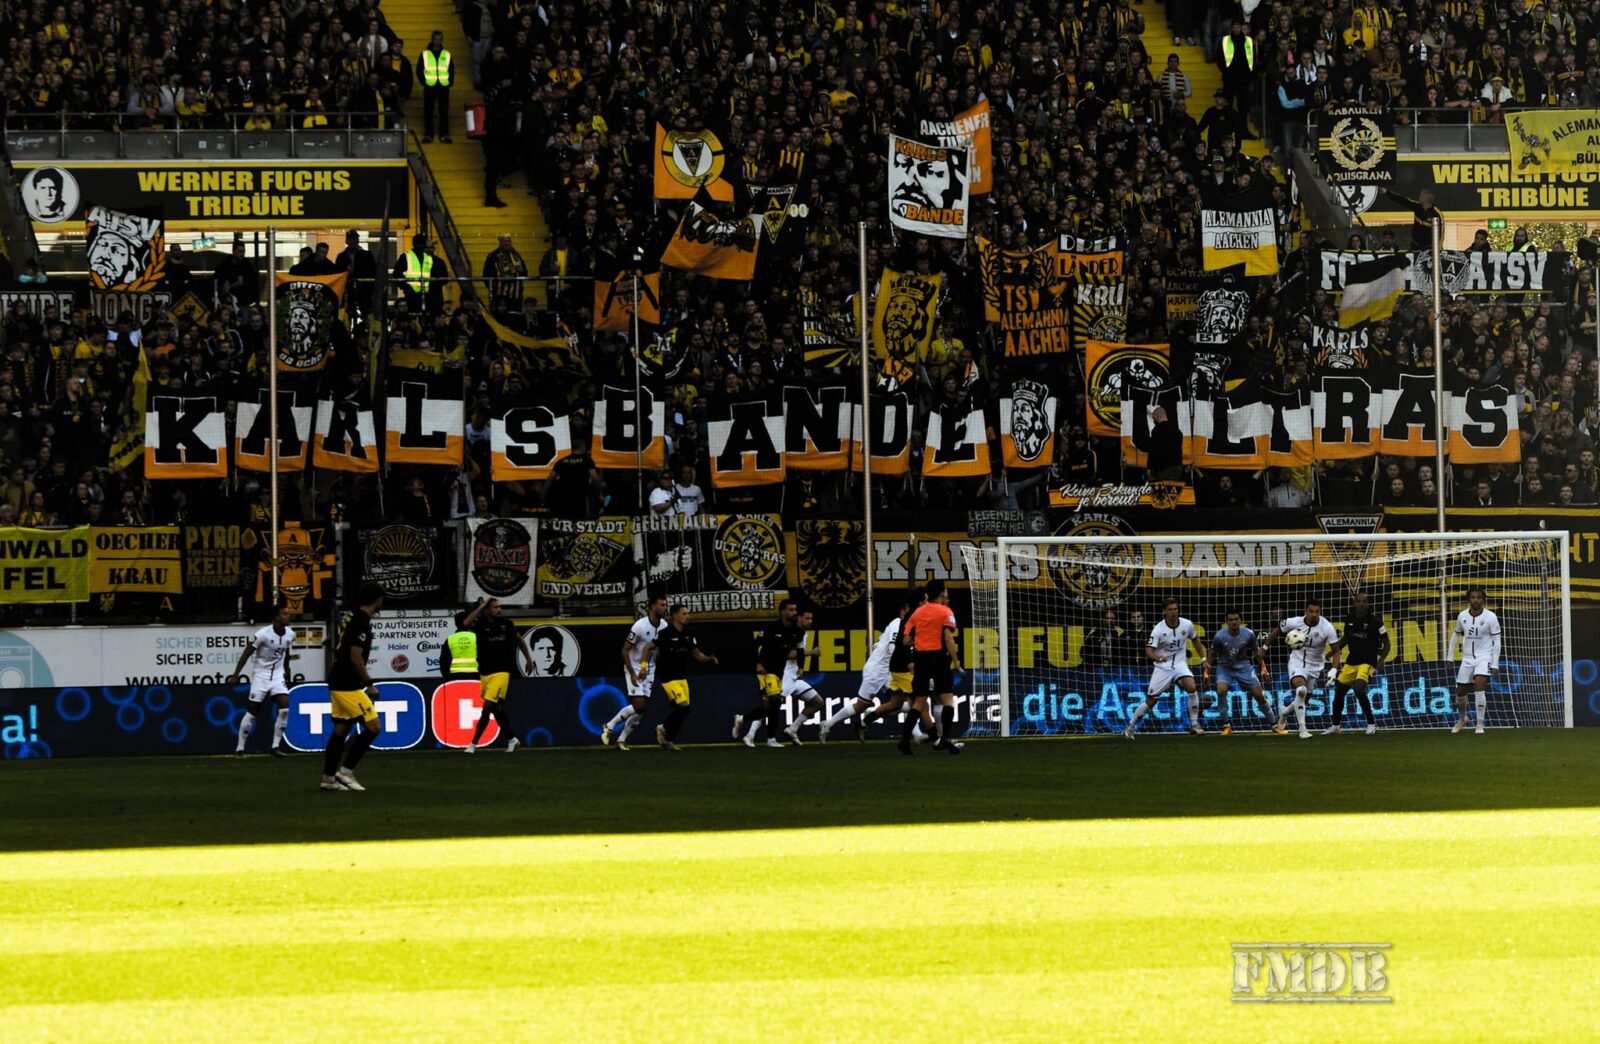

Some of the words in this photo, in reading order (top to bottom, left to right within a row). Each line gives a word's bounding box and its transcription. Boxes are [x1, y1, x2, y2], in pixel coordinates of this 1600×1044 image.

[919, 112, 990, 137] AACHENER
[895, 138, 948, 162] KARLS
[138, 171, 255, 192] WERNER
[265, 170, 352, 191] FUCHS
[1327, 170, 1392, 181] AQUISGRANA
[185, 192, 305, 217] TRIBÜNE
[1477, 185, 1589, 208] TRIBÜNE
[88, 206, 161, 241] ATSV
[906, 206, 964, 226] BANDE
[1204, 210, 1272, 229] ALEMANNIA
[1060, 234, 1117, 251] DREI
[1214, 232, 1259, 250] AACHEN
[1466, 251, 1548, 290] ATSV
[1003, 284, 1040, 312] TSV
[1001, 308, 1070, 331] ALEMANNIA
[1003, 327, 1071, 357] AACHEN
[1312, 325, 1369, 351] KARLS
[632, 514, 680, 534] GEGEN
[682, 513, 718, 530] ALLE
[968, 510, 1024, 522] LEGENDEN
[1070, 513, 1122, 527] KARLS
[1325, 517, 1377, 527] ALEMANNIA
[541, 519, 573, 533] FÜR
[574, 520, 626, 534] STADT
[185, 525, 241, 549] PYRO
[186, 557, 241, 576] KEIN
[873, 541, 1040, 581] KARLS
[1152, 542, 1316, 578] BANDE
[109, 567, 168, 586] KRAU
[378, 577, 421, 589] TIVOLI
[541, 582, 572, 596] UND
[574, 582, 626, 596] VEREIN
[384, 620, 448, 629] AUTORISIERTER
[156, 637, 202, 649] SICHER
[156, 653, 203, 665] SICHER
[1023, 683, 1084, 721] die
[1403, 676, 1451, 716] da
